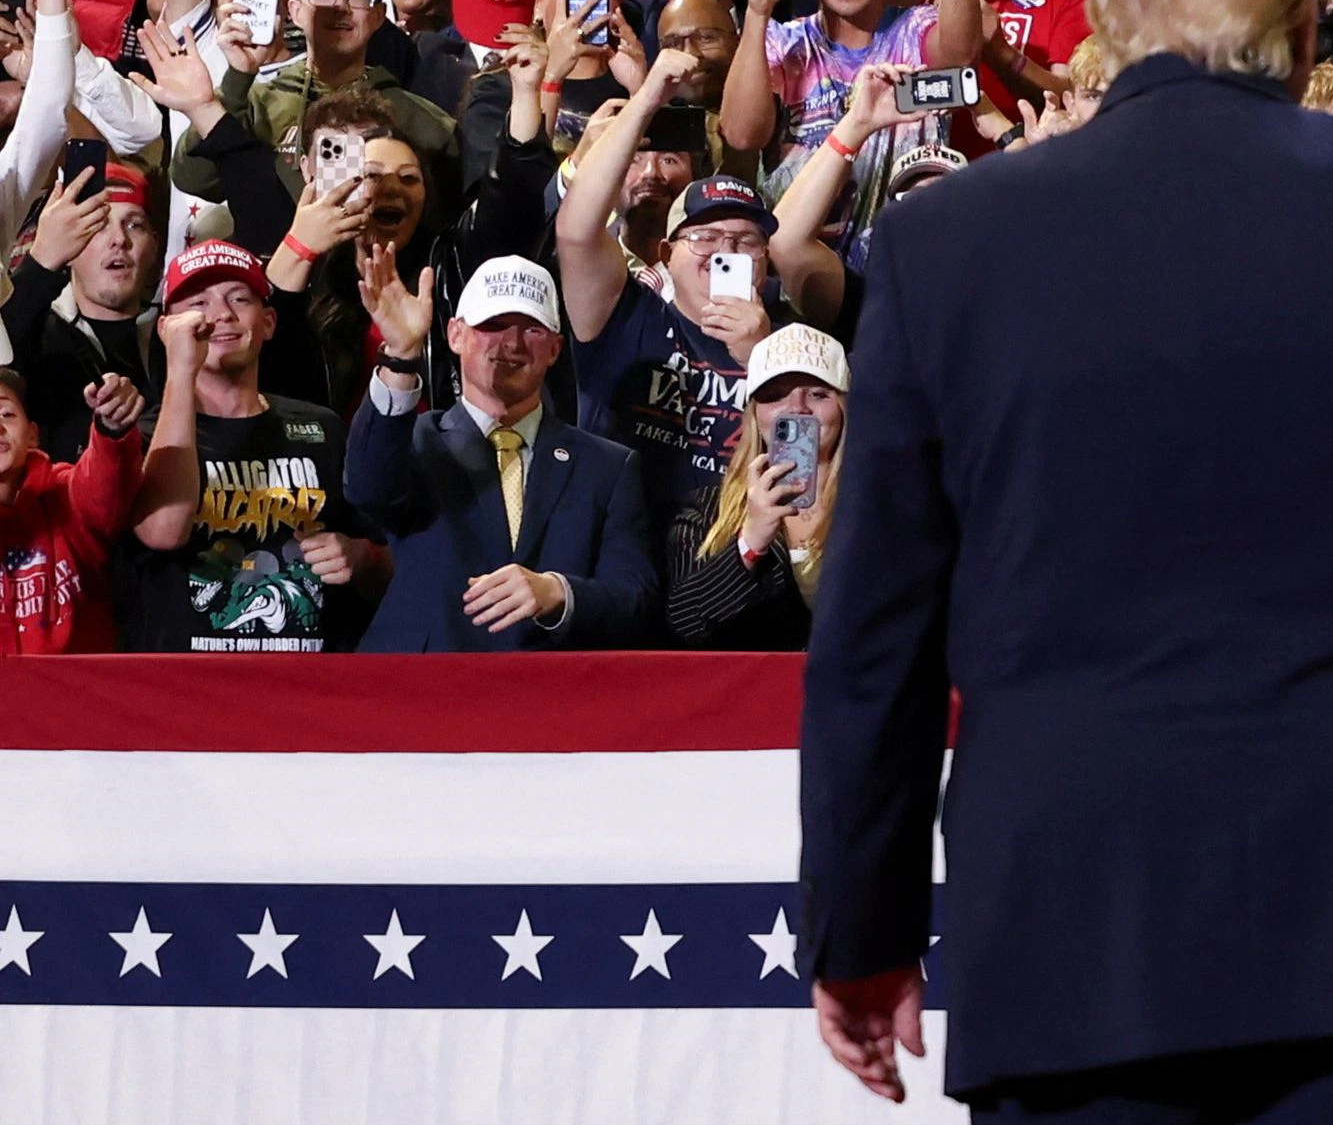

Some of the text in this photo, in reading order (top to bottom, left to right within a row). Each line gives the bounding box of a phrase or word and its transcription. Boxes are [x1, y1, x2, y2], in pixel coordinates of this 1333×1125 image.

[900, 147, 961, 170] HUSTED
[716, 181, 755, 198] DAVID
[177, 244, 253, 267] MAKE AMERICA
[181, 256, 250, 275] GREAT AGAIN
[485, 271, 549, 296] MAKE AMERICA
[487, 283, 546, 305] GREAT AGAIN
[767, 327, 831, 344] TRUMP
[766, 341, 829, 360] FORCE
[764, 356, 830, 371] CAPTAIN
[286, 423, 321, 435] FABER
[635, 421, 671, 444] TAKE
[205, 457, 320, 492] ALLIGATOR
[193, 486, 327, 541] ALCATRAZ
[190, 636, 235, 652] NATURE'S
[236, 637, 261, 652] OWN
[261, 636, 300, 652] BORDER
